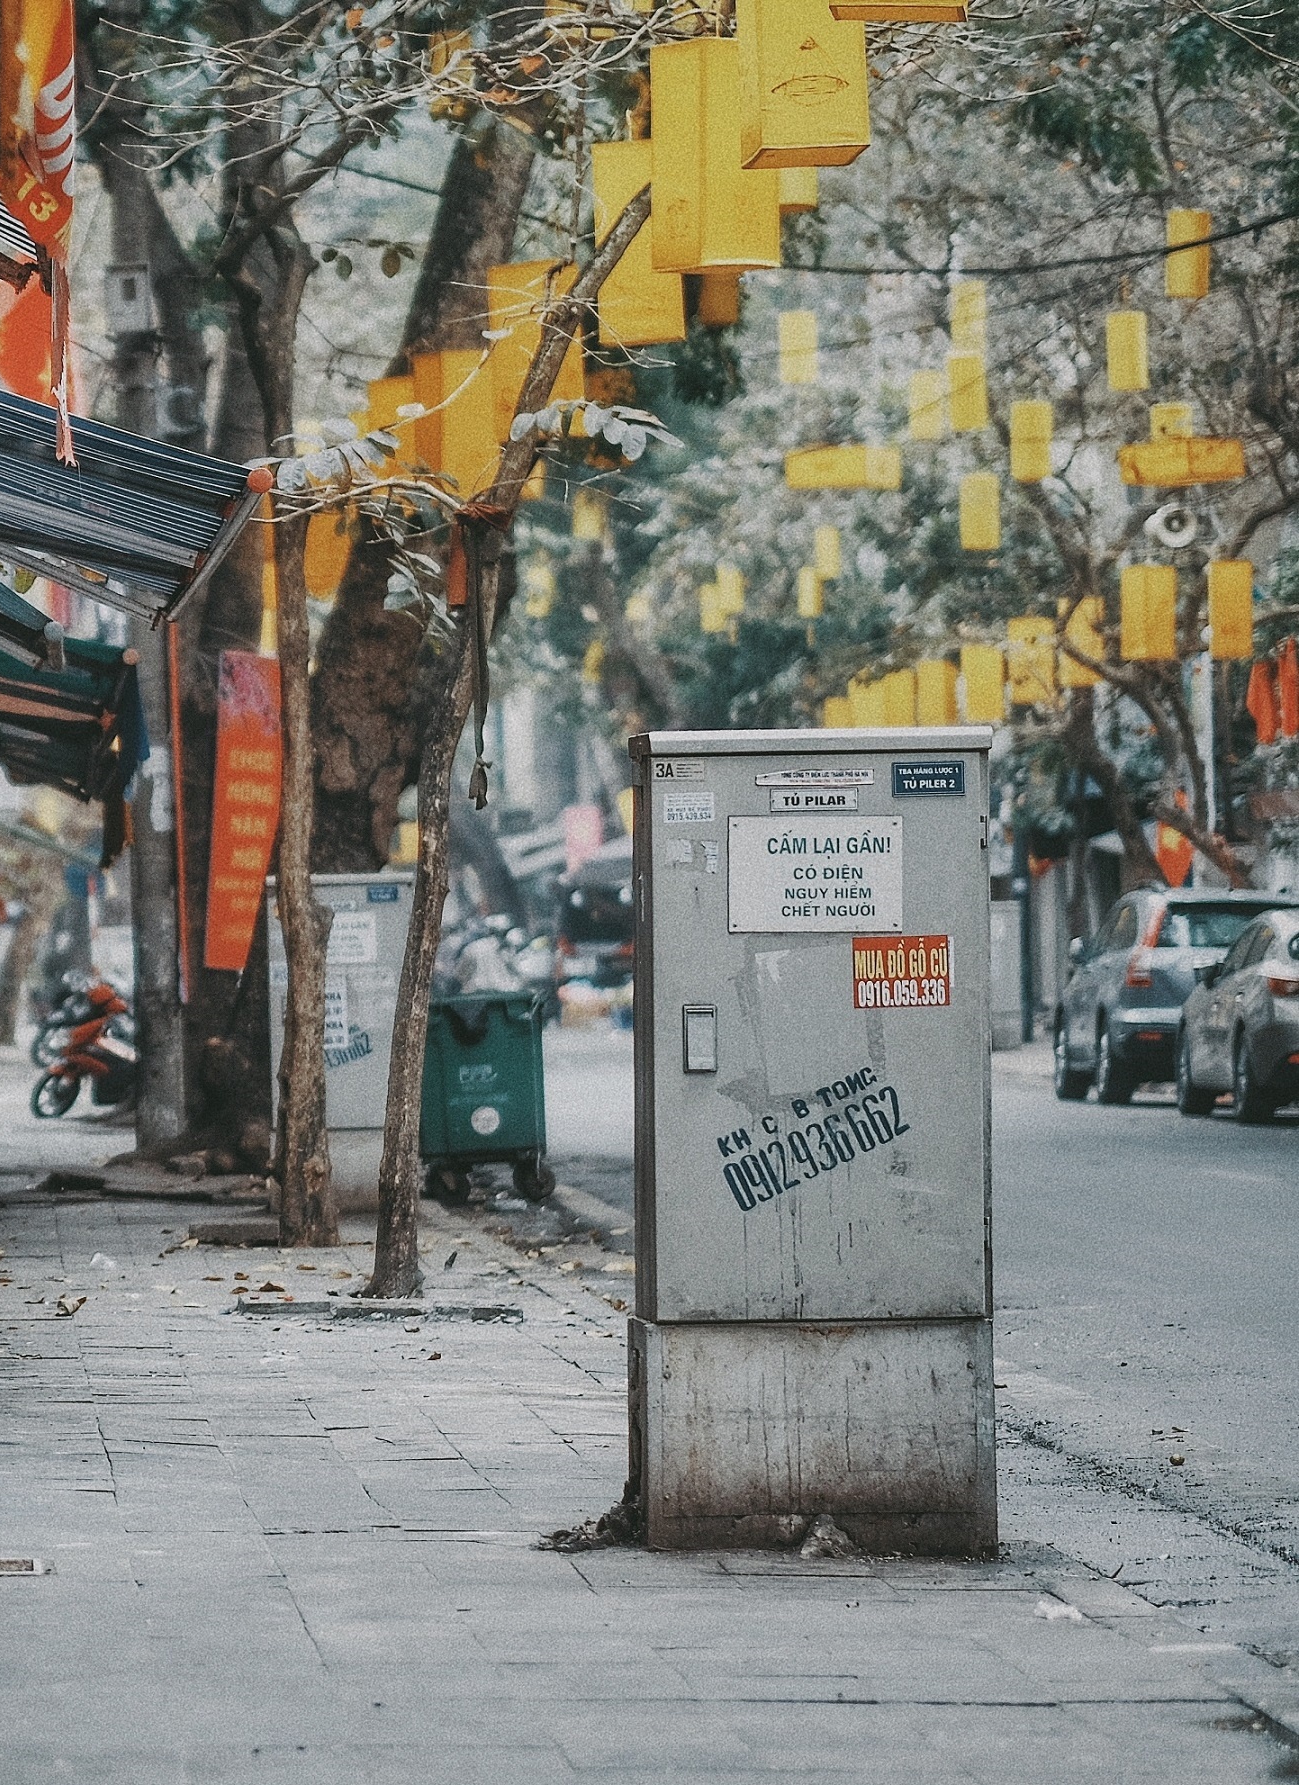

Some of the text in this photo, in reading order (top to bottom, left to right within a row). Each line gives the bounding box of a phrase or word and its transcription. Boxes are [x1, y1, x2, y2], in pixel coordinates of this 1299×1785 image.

[655, 763, 675, 778] 3A
[919, 779, 947, 789] PILER
[948, 779, 956, 788] 2
[805, 795, 846, 806] PILAR
[767, 829, 891, 860] CẤM LẠI GẦN!
[793, 863, 863, 883] CÓ ĐIỆN
[785, 881, 872, 899] NGUY HIỂM
[782, 900, 876, 917] CHẾT NGƯỜI
[854, 937, 948, 980] MUA ĐỒ GỖ CŨ
[858, 978, 946, 1008] 0916.059.336
[791, 1099, 810, 1119] B
[722, 1085, 912, 1212] 0912936662
